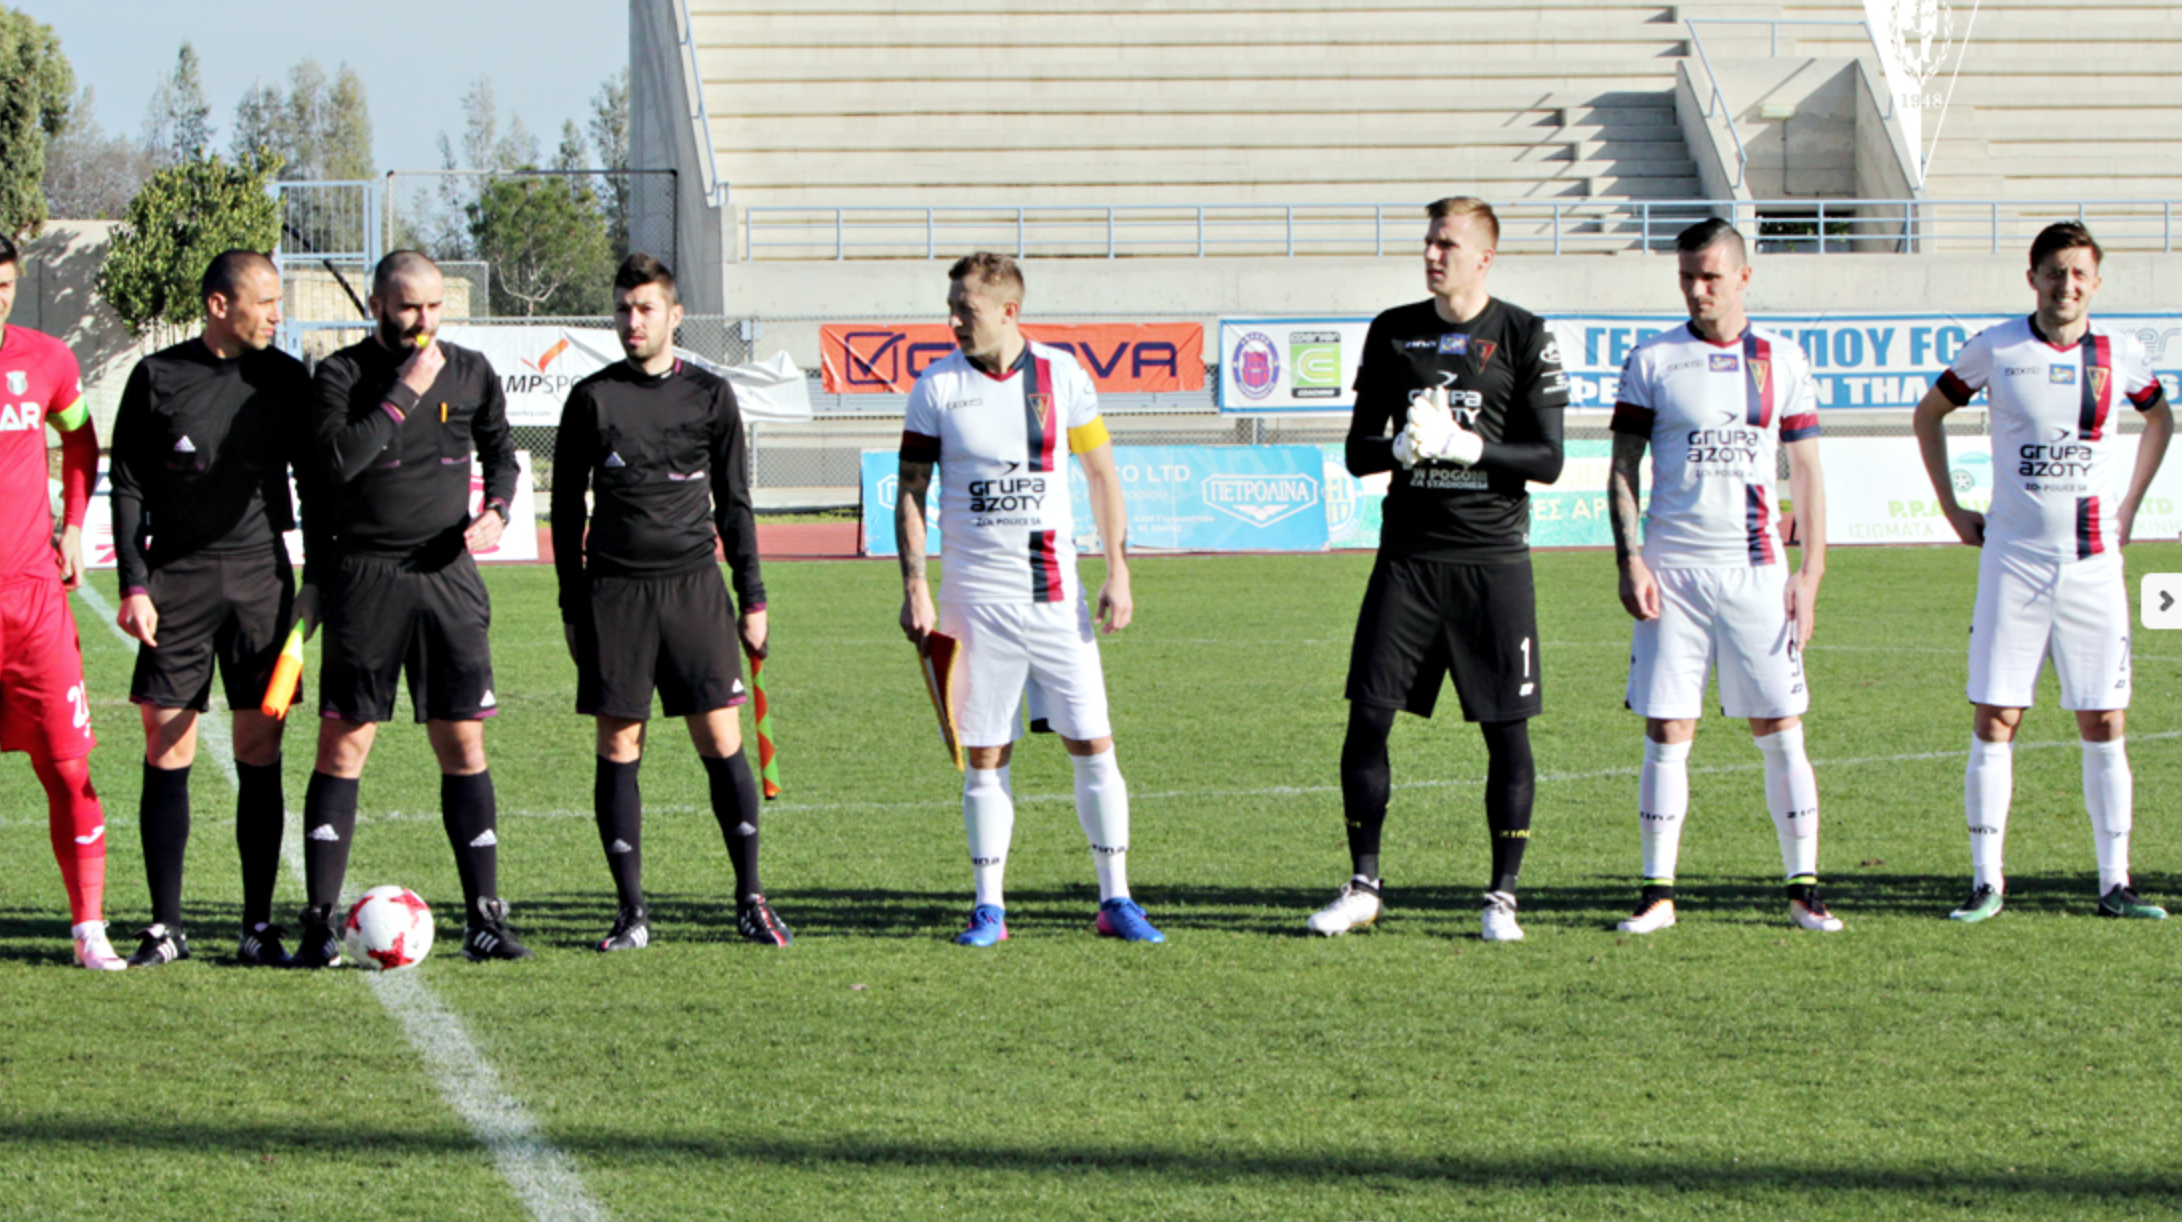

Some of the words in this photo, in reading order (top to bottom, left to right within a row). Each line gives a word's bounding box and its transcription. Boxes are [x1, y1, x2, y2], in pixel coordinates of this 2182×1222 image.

[1910, 326, 1967, 366] FC
[1147, 465, 1191, 482] LTD
[1430, 468, 1489, 482] POGONI
[1211, 480, 1310, 502] ΠΕΤΡΟΛΙΝΑ
[996, 517, 1028, 526] POLICE
[1520, 637, 1531, 677] 1
